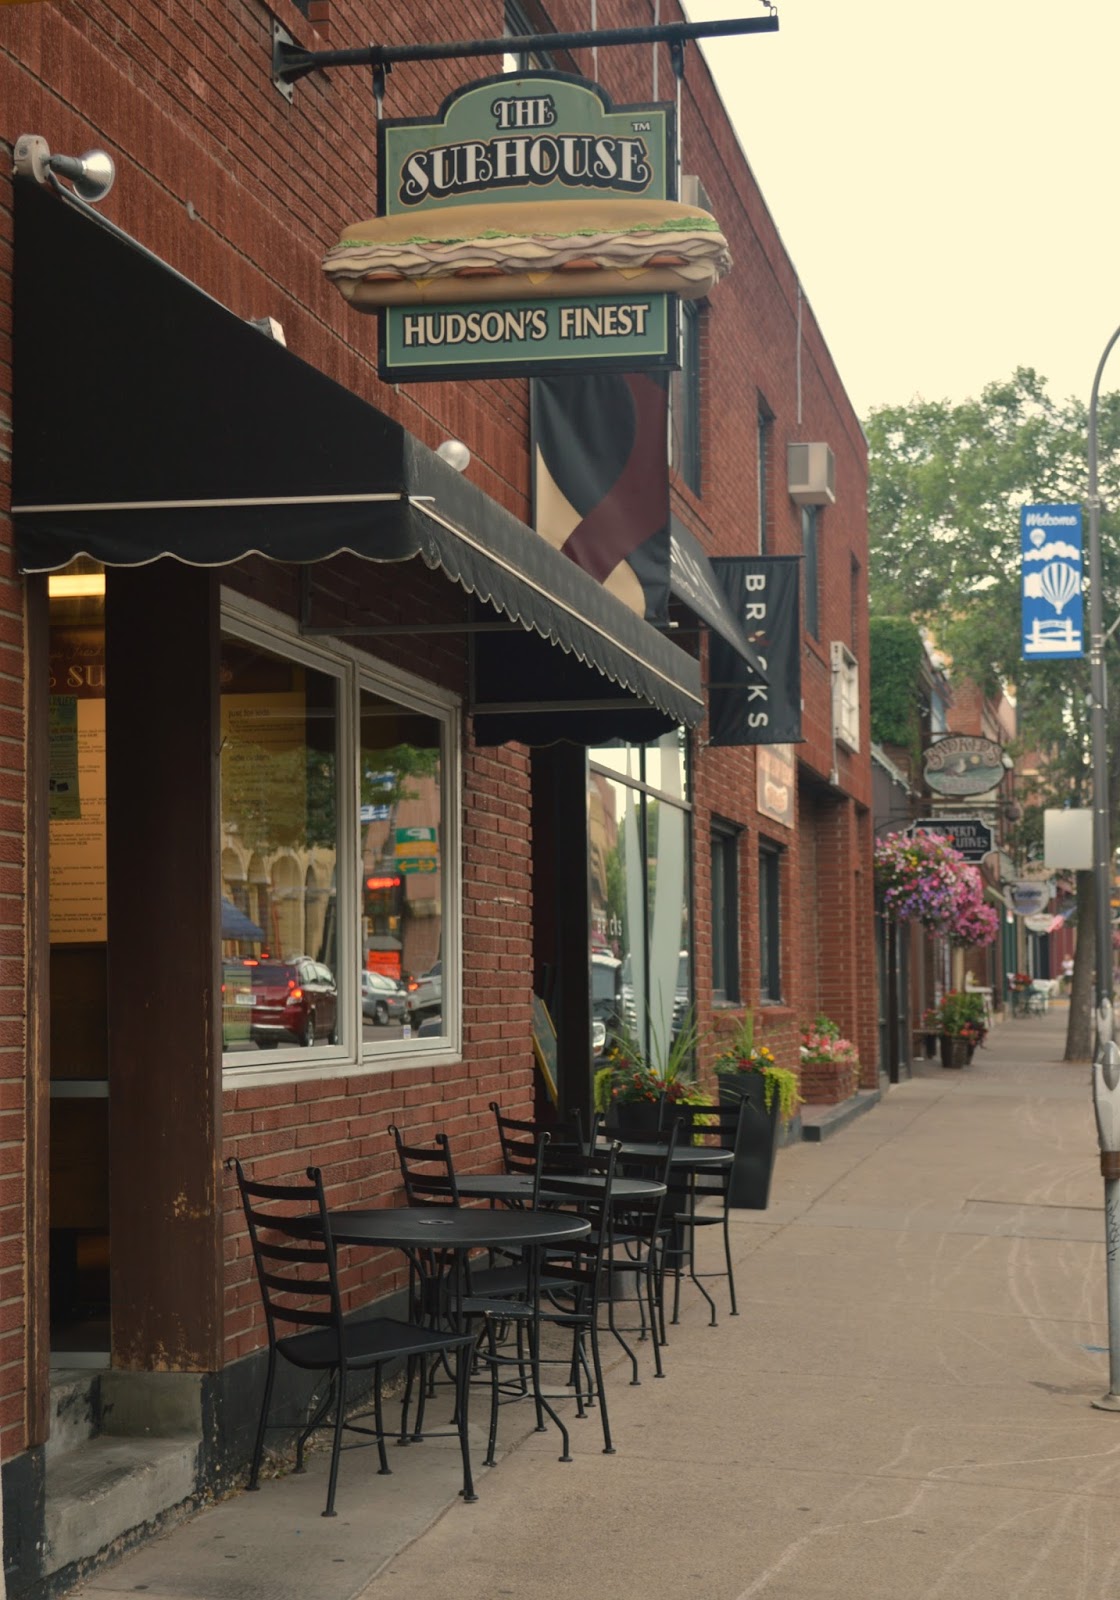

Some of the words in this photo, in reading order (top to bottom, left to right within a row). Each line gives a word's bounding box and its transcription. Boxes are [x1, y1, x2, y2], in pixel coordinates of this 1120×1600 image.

[493, 97, 555, 128] THE
[403, 136, 651, 198] SUBHOUSE
[404, 309, 547, 346] HUDSON'S
[560, 304, 649, 339] FINEST
[1026, 512, 1078, 526] Welcome
